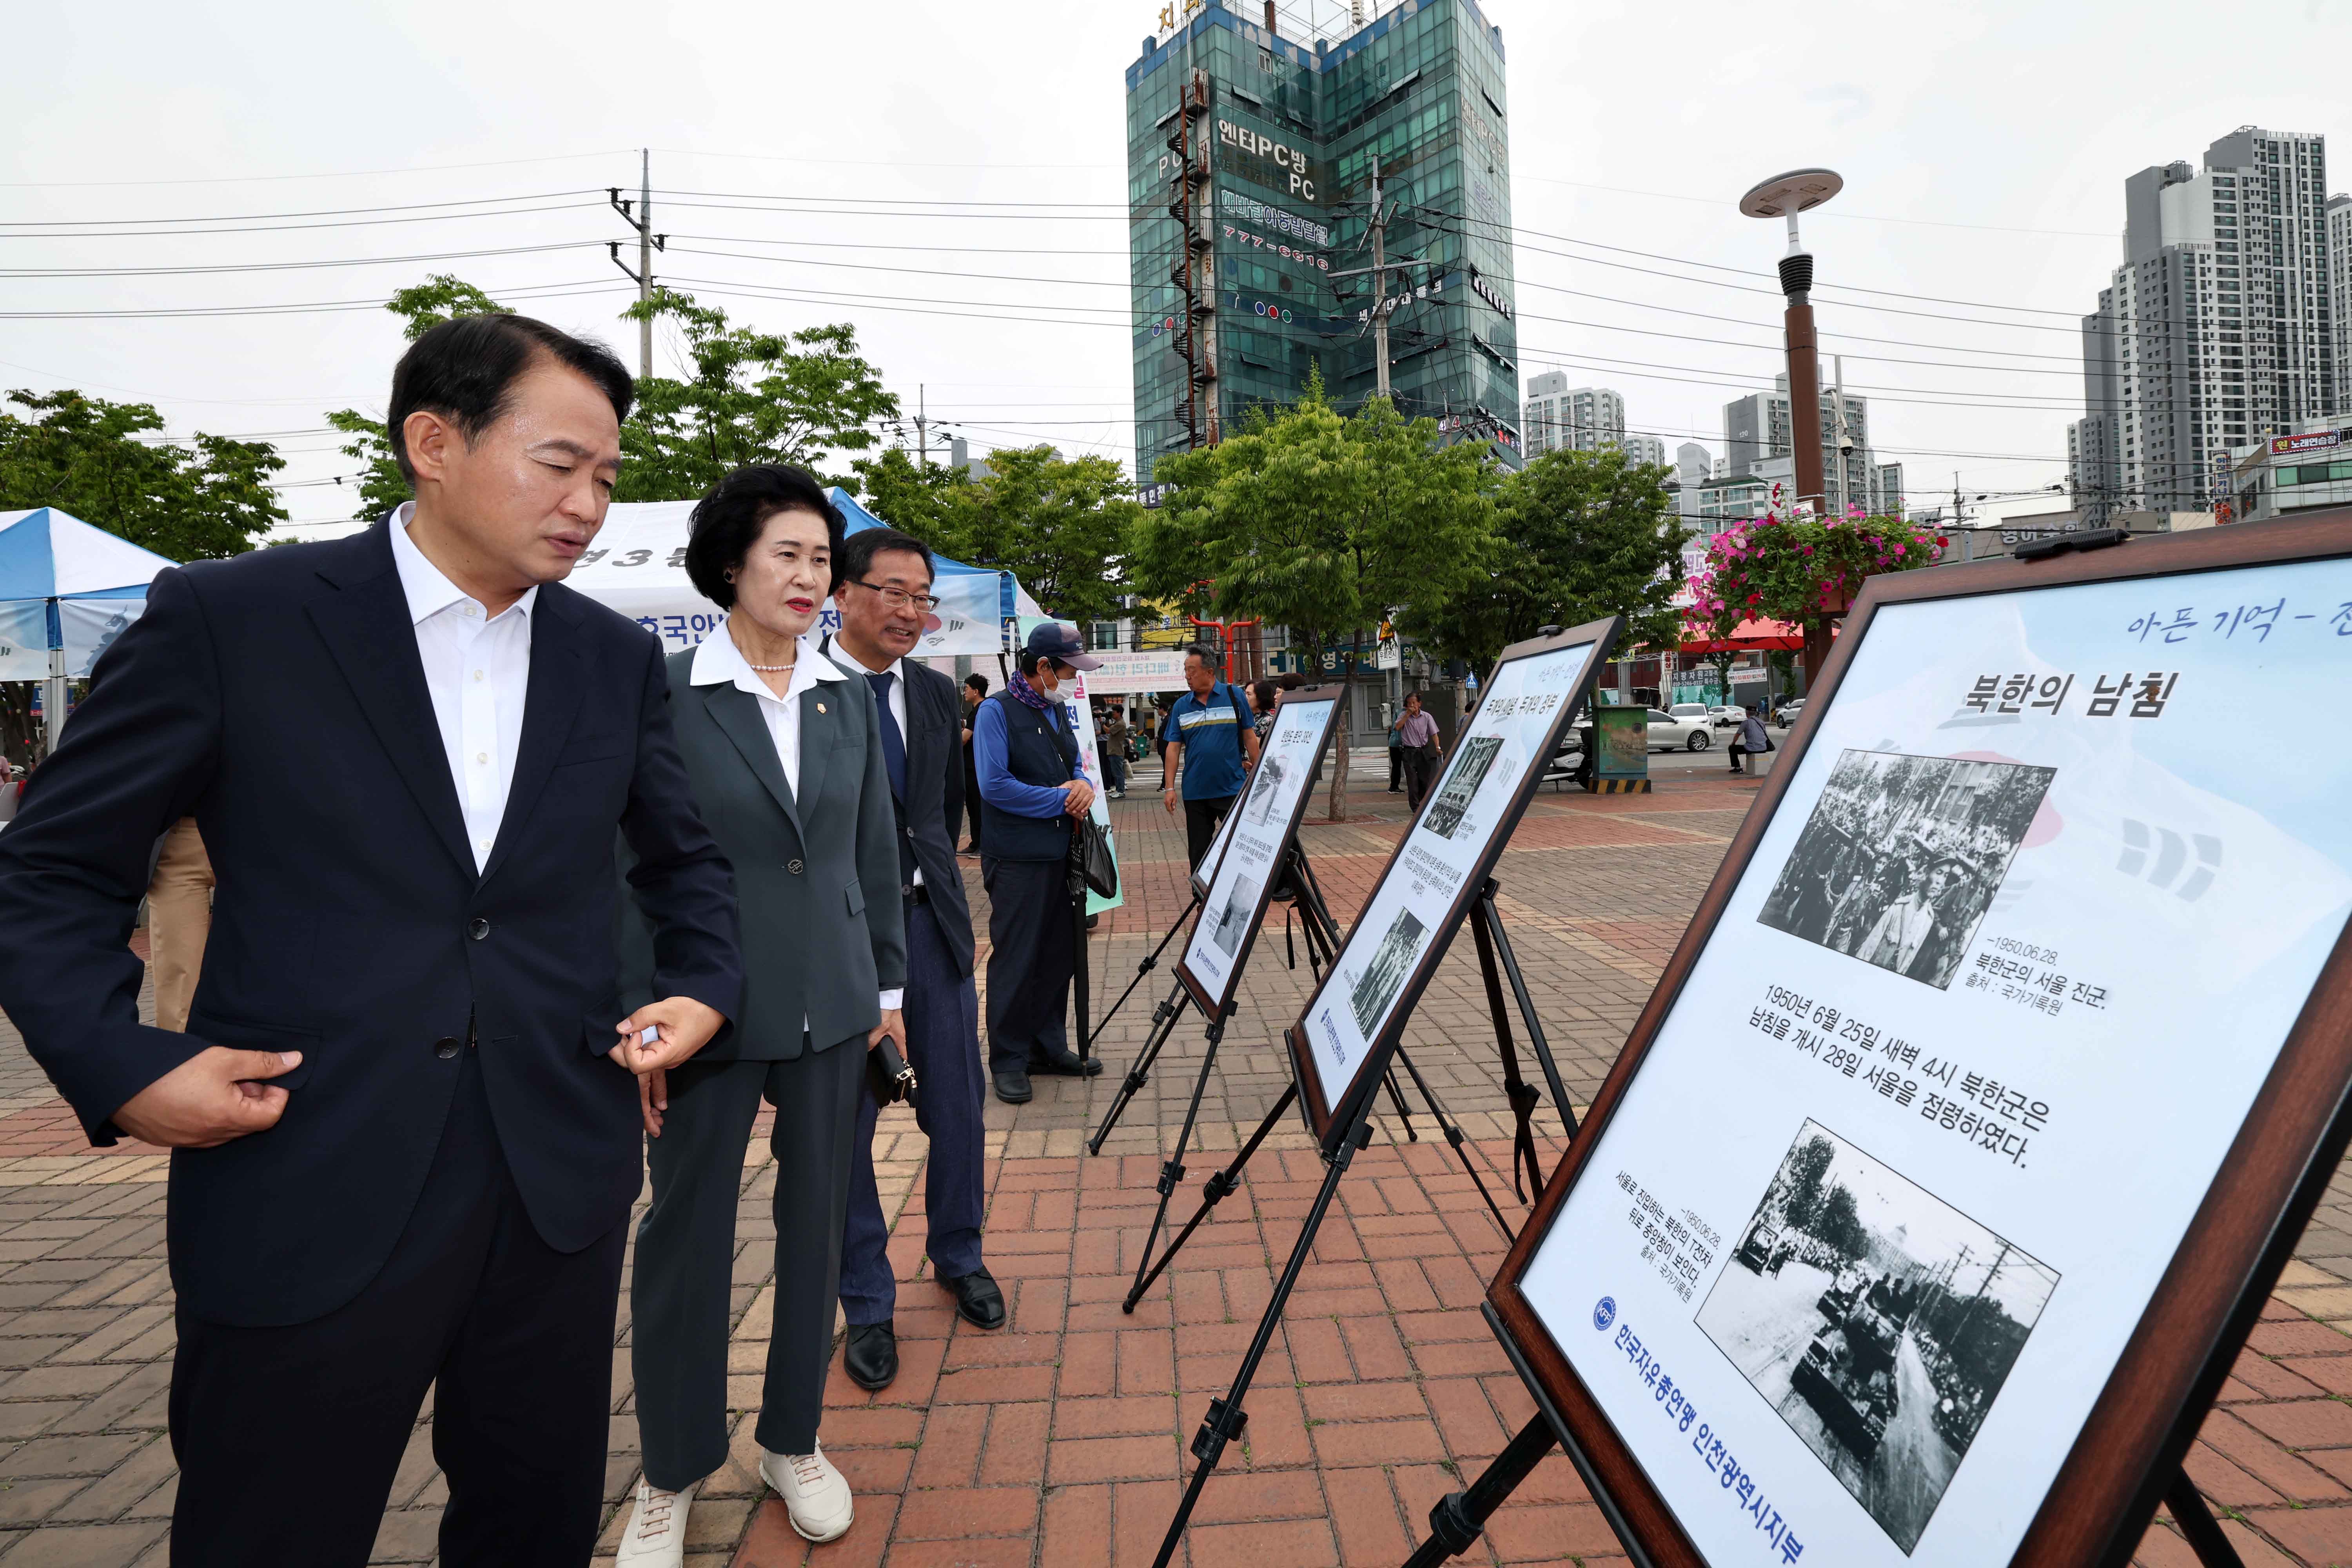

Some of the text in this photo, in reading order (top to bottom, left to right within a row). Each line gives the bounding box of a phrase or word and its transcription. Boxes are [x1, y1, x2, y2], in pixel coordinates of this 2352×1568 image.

[1218, 118, 1307, 174] 엔터PC방
[1290, 172, 1315, 201] PC
[1223, 225, 1329, 270] 777-6616
[2276, 435, 2337, 450] 원 노래연습장
[636, 613, 724, 644] 호국안
[2128, 607, 2199, 643] 아픈
[2213, 598, 2286, 643] 기억
[1485, 698, 1506, 716] 두개의
[1518, 693, 1543, 715] 두개의
[1538, 692, 1561, 714] 정부
[1966, 672, 2180, 718] 북한의 남침
[1987, 936, 2058, 966] -1950.06.28.
[1965, 972, 1991, 992] 출처
[2001, 984, 2063, 1016] 국가기록원
[1976, 953, 2107, 1009] 북한군의 서울 진군.
[1764, 984, 2050, 1133] 1950년 6월 25일 새벽 4시 북한군은
[1749, 1005, 2029, 1169] 남침을 개시 28일 서울을 점령하였다.
[1615, 1170, 1713, 1269] 서울로 진입하는 북한의 T전차
[1681, 1208, 1721, 1250] -1950.06.28.
[1628, 1207, 1700, 1289] 뒤로 중앙청이 보인다.
[1640, 1245, 1657, 1265] 출처
[1659, 1263, 1693, 1304] 국가기록원
[1597, 1304, 1612, 1321] KFF
[1614, 1323, 1804, 1565] 한국자유총연맹 인천광역시지부
